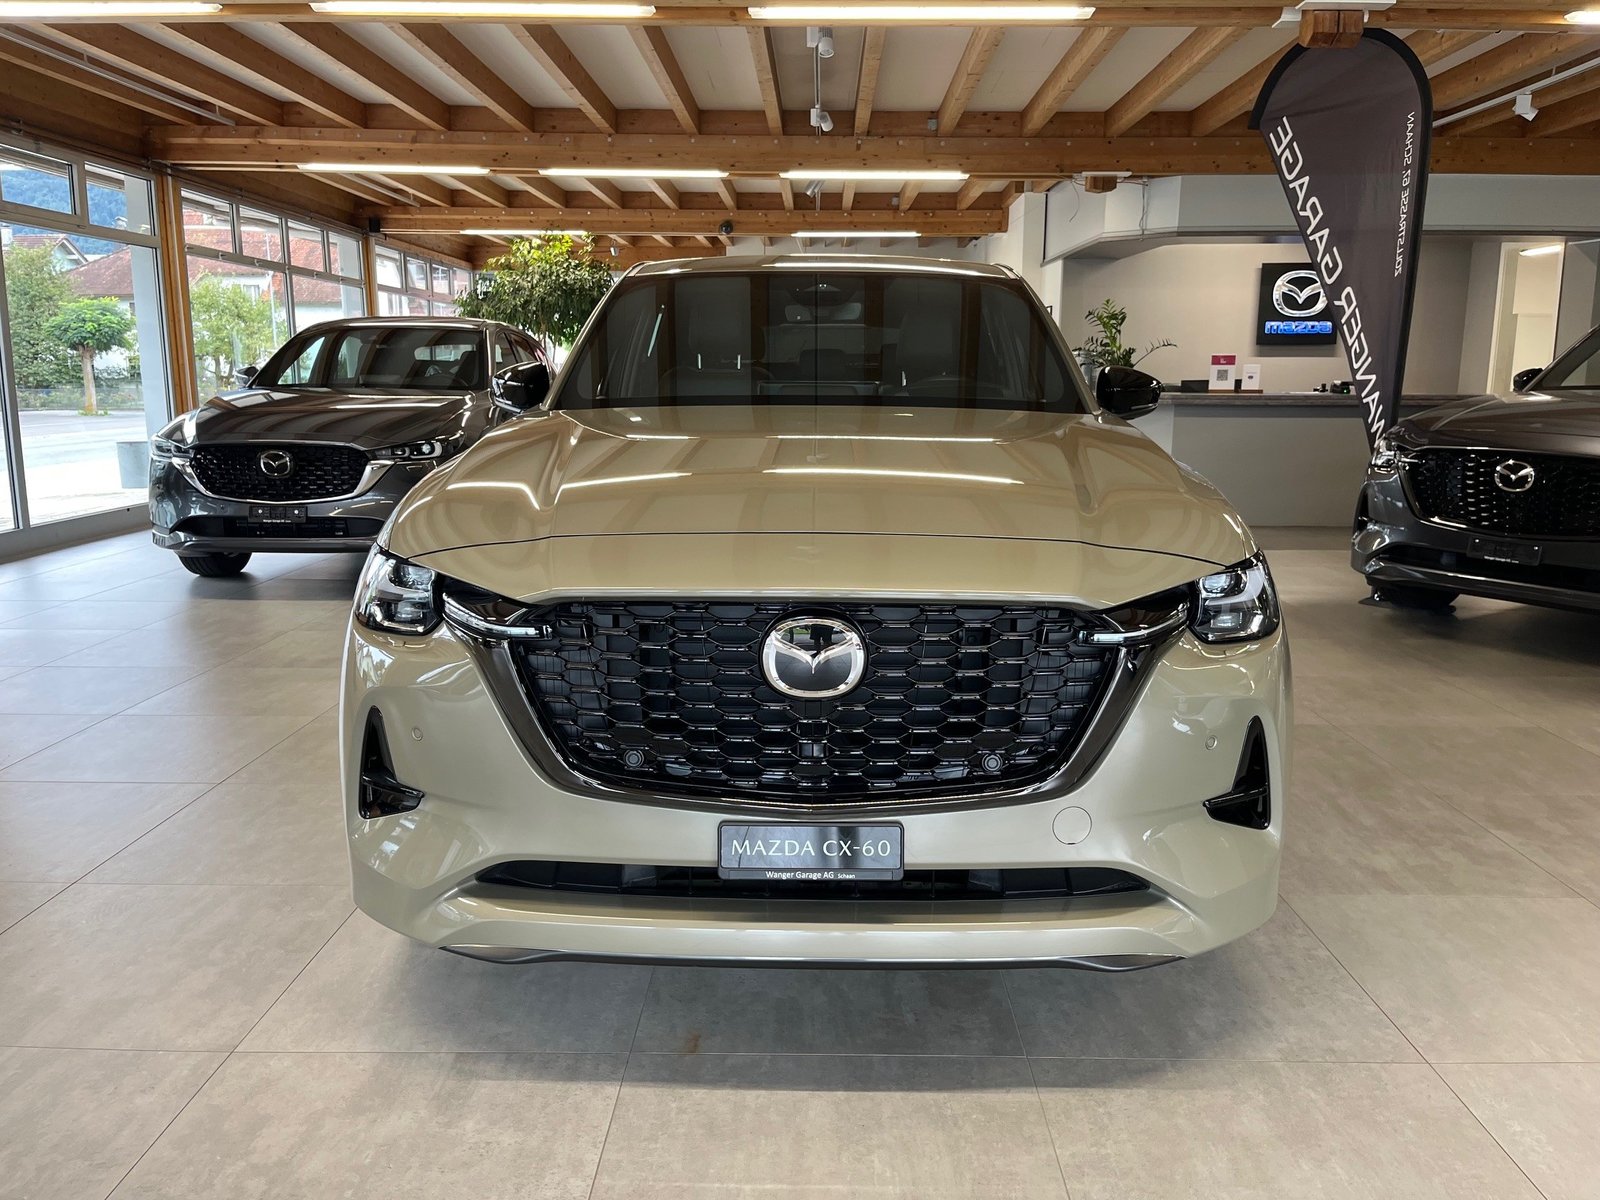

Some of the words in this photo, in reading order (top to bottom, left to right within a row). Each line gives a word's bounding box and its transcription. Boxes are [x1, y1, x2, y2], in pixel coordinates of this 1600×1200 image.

[731, 839, 815, 856] MAZDA
[822, 839, 891, 857] CX-60
[765, 871, 795, 880] Wanger
[795, 871, 822, 880] Garage
[822, 871, 834, 879] AG
